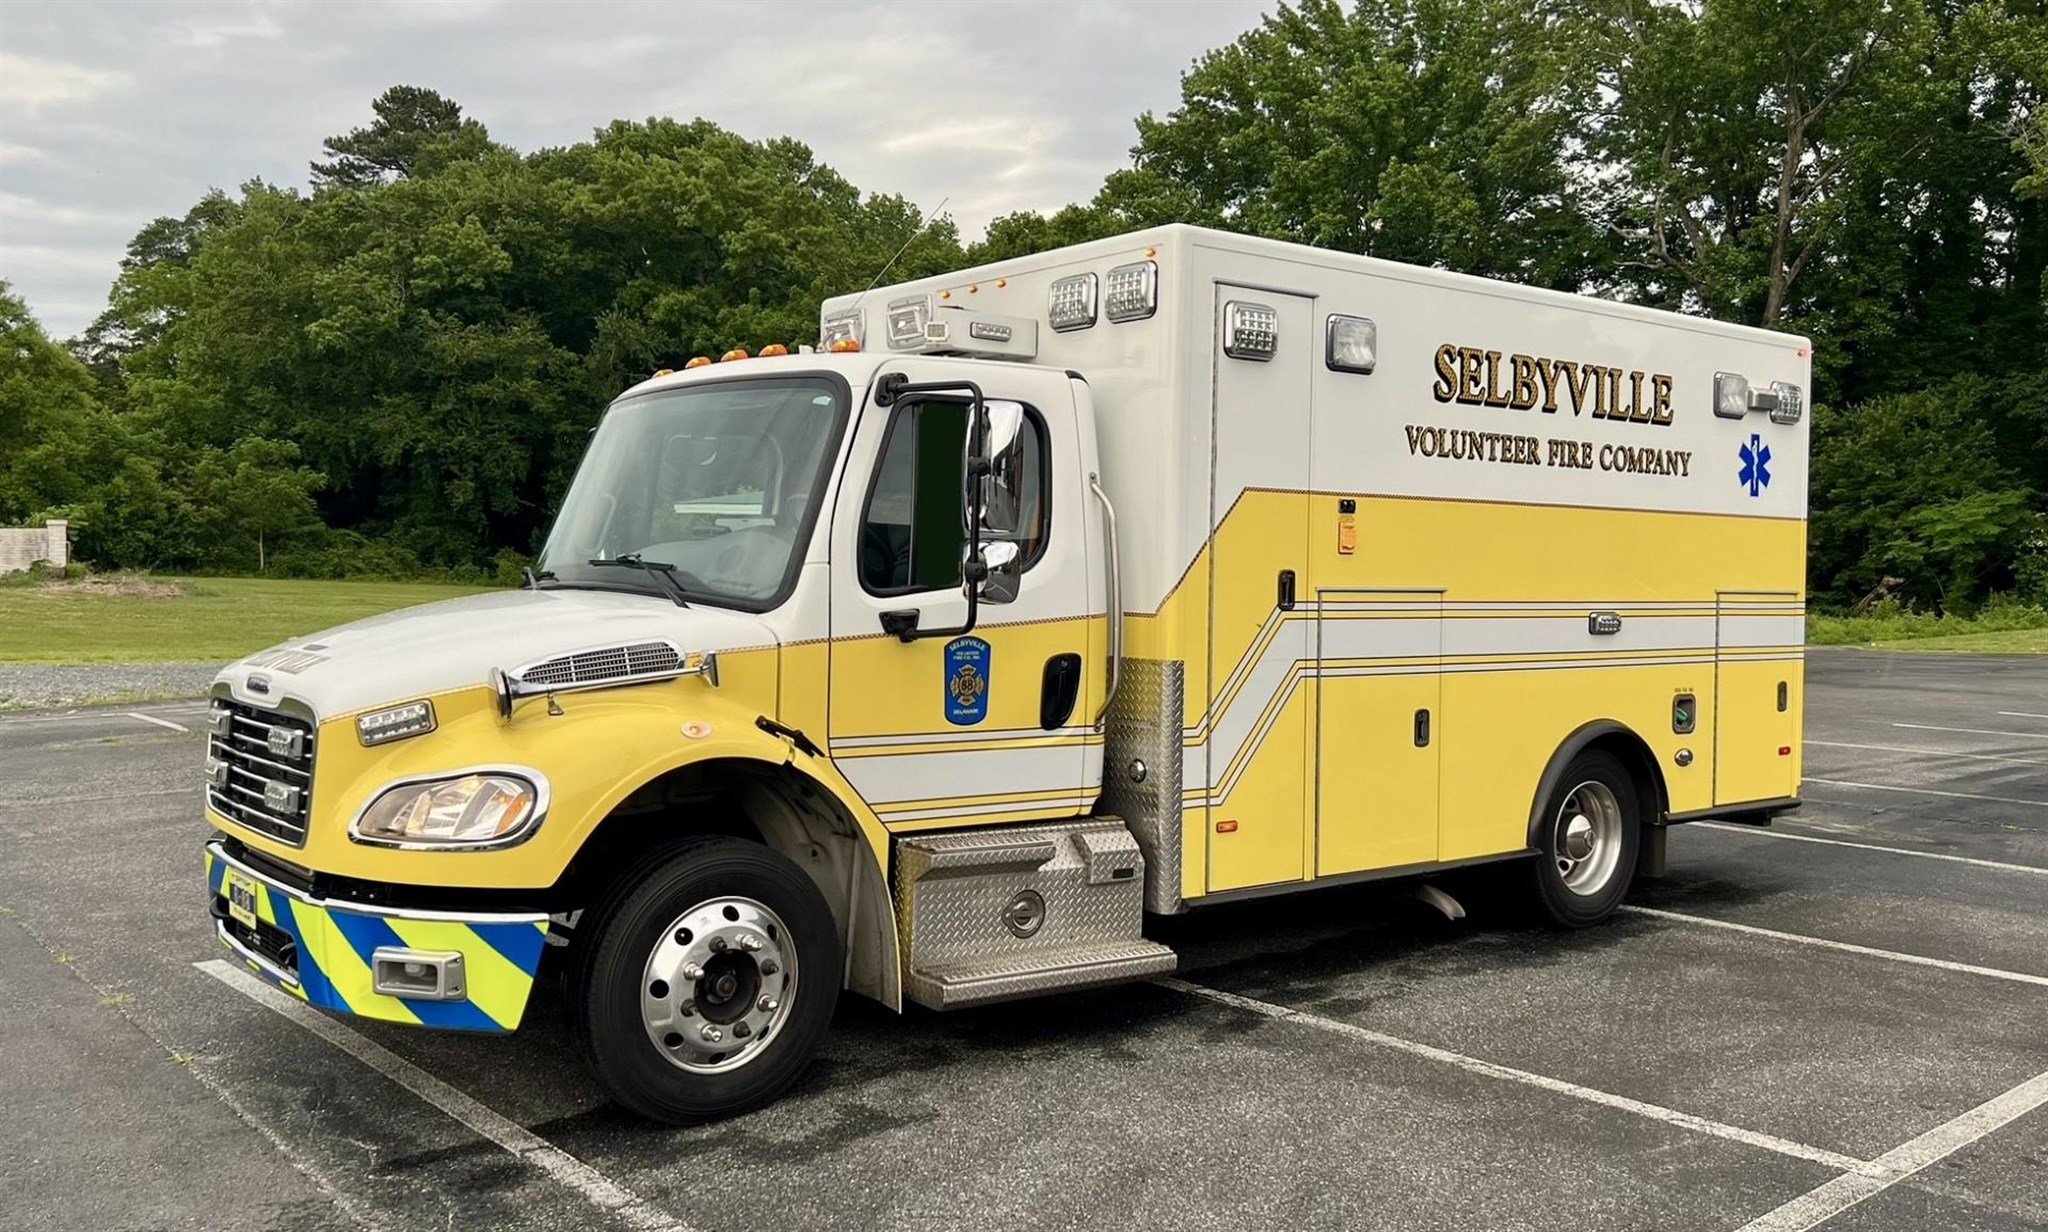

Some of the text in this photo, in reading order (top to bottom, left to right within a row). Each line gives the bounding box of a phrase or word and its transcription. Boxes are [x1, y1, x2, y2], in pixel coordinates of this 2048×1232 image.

[1433, 343, 1674, 426] SELBYVILLE
[1405, 425, 1692, 477] VOLUNTEER FIRE COMPANY
[949, 639, 985, 651] SELBYVILLE
[961, 680, 973, 691] 88
